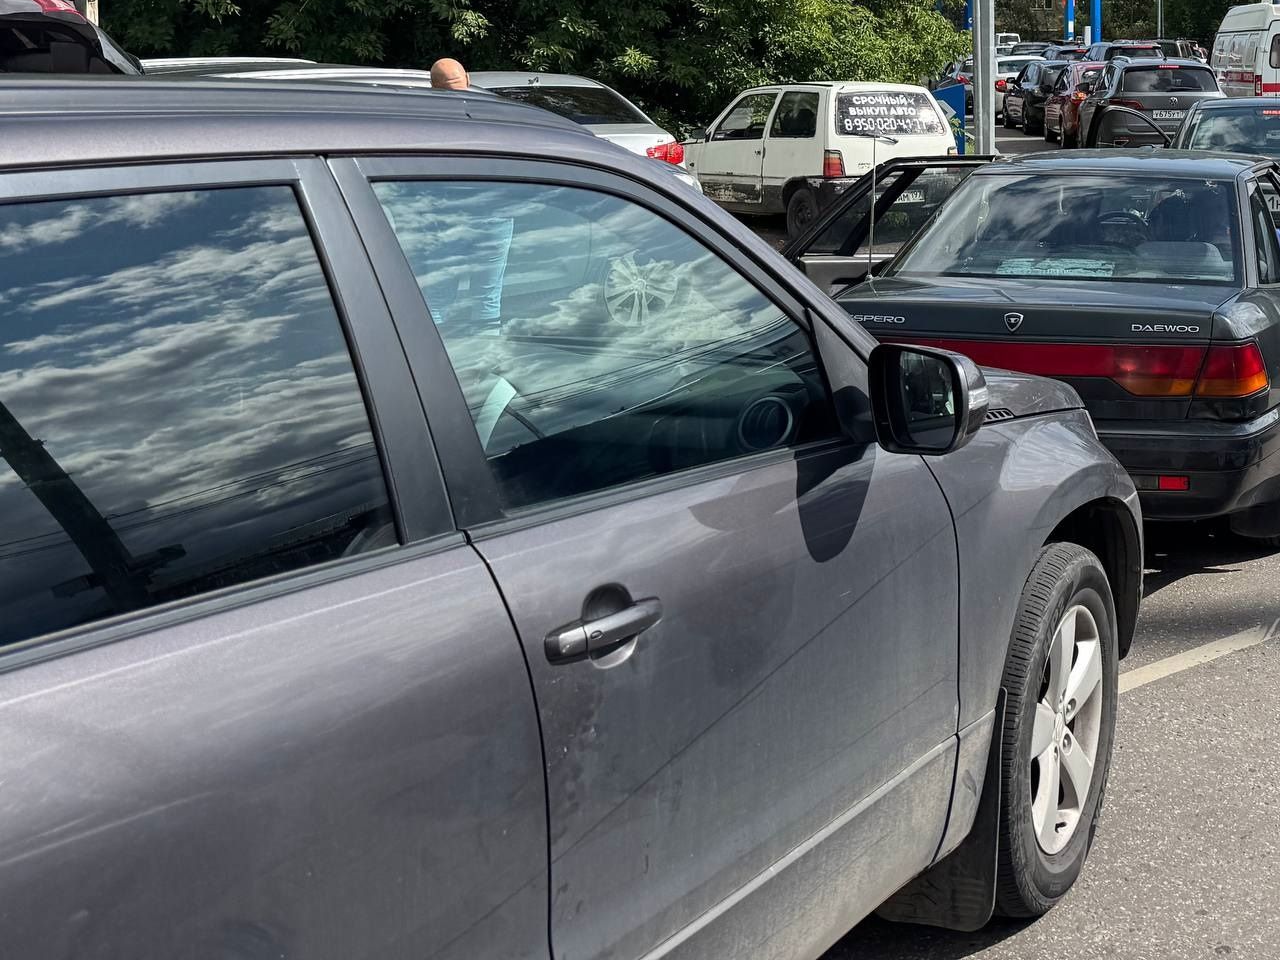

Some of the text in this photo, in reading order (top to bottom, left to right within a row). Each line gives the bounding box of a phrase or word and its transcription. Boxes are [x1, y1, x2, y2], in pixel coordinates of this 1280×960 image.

[852, 95, 908, 105] СРОЧНЫЙ
[848, 107, 917, 116] ВЫКУП АВТО
[1131, 324, 1200, 333] DAEWOO
